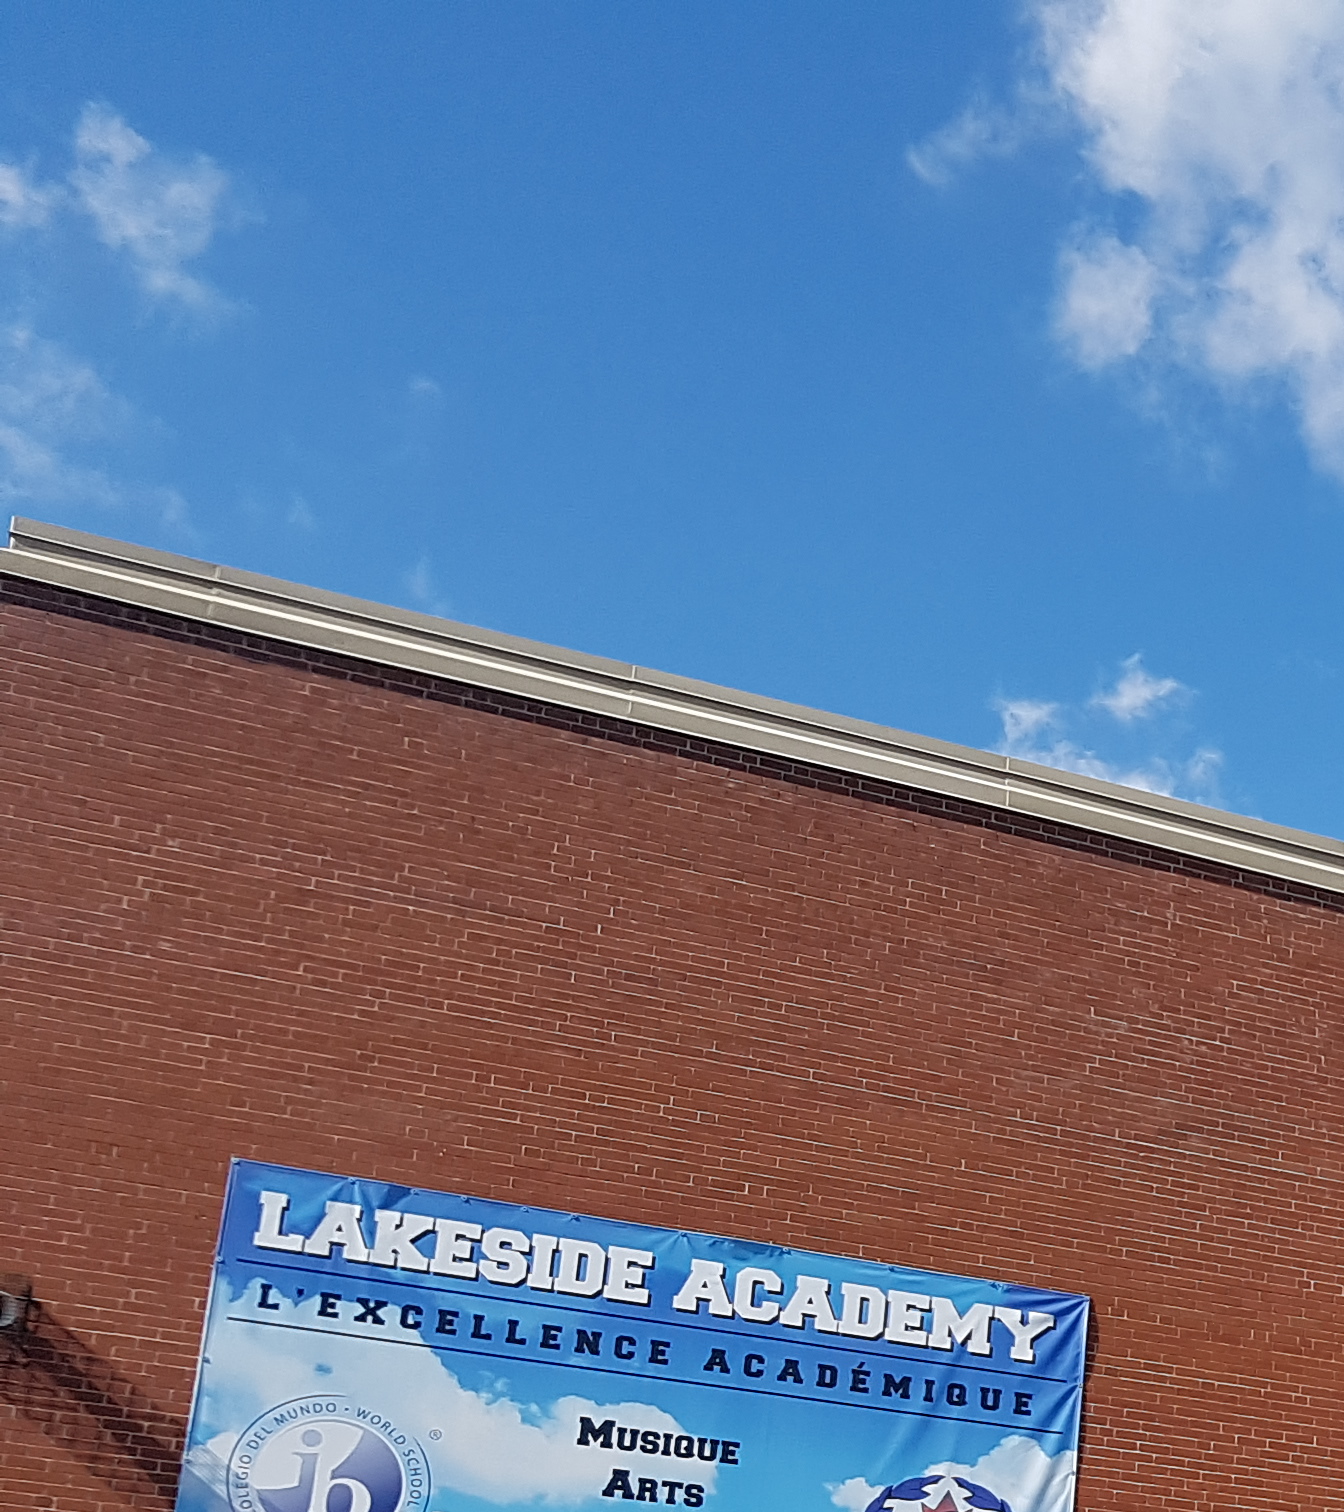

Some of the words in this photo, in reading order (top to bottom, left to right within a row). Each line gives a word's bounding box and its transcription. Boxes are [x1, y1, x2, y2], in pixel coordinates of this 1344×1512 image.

[253, 1190, 656, 1306] LAKESIDE
[672, 1257, 1055, 1364] ACADEMY
[256, 1283, 672, 1365] L'EXCELLENCE
[702, 1349, 1034, 1417] ACADÉMIQUE
[247, 1425, 274, 1451] DEL
[273, 1402, 338, 1427] MUNDO
[356, 1407, 407, 1446] WORLD
[402, 1449, 423, 1507] SCHOOL
[576, 1416, 741, 1465] MUSIQUE
[602, 1468, 706, 1507] ARTS
